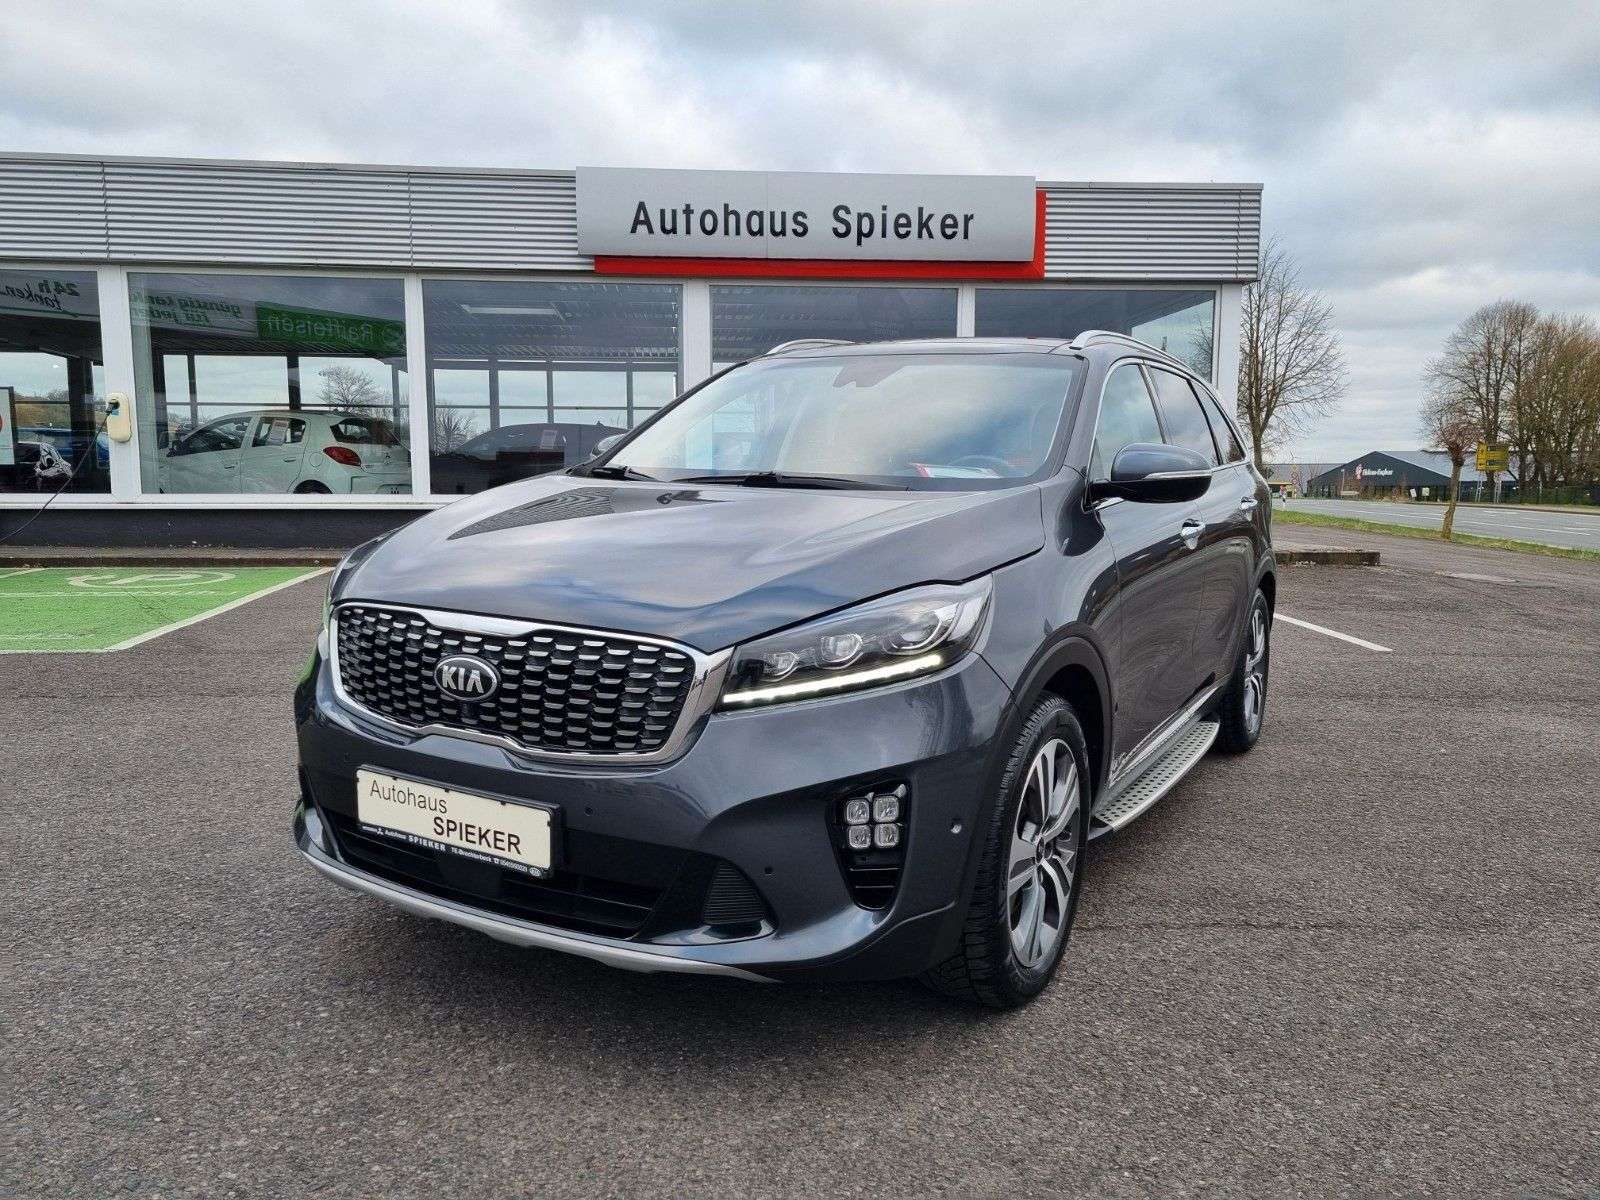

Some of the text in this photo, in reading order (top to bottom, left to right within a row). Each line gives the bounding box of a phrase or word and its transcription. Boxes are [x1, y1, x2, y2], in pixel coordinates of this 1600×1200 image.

[630, 201, 975, 247] Autohaus Spieker
[442, 664, 484, 694] KIA
[370, 779, 448, 814] Autohaus
[408, 834, 447, 852] SPIEKER
[433, 816, 523, 856] SPIEKER
